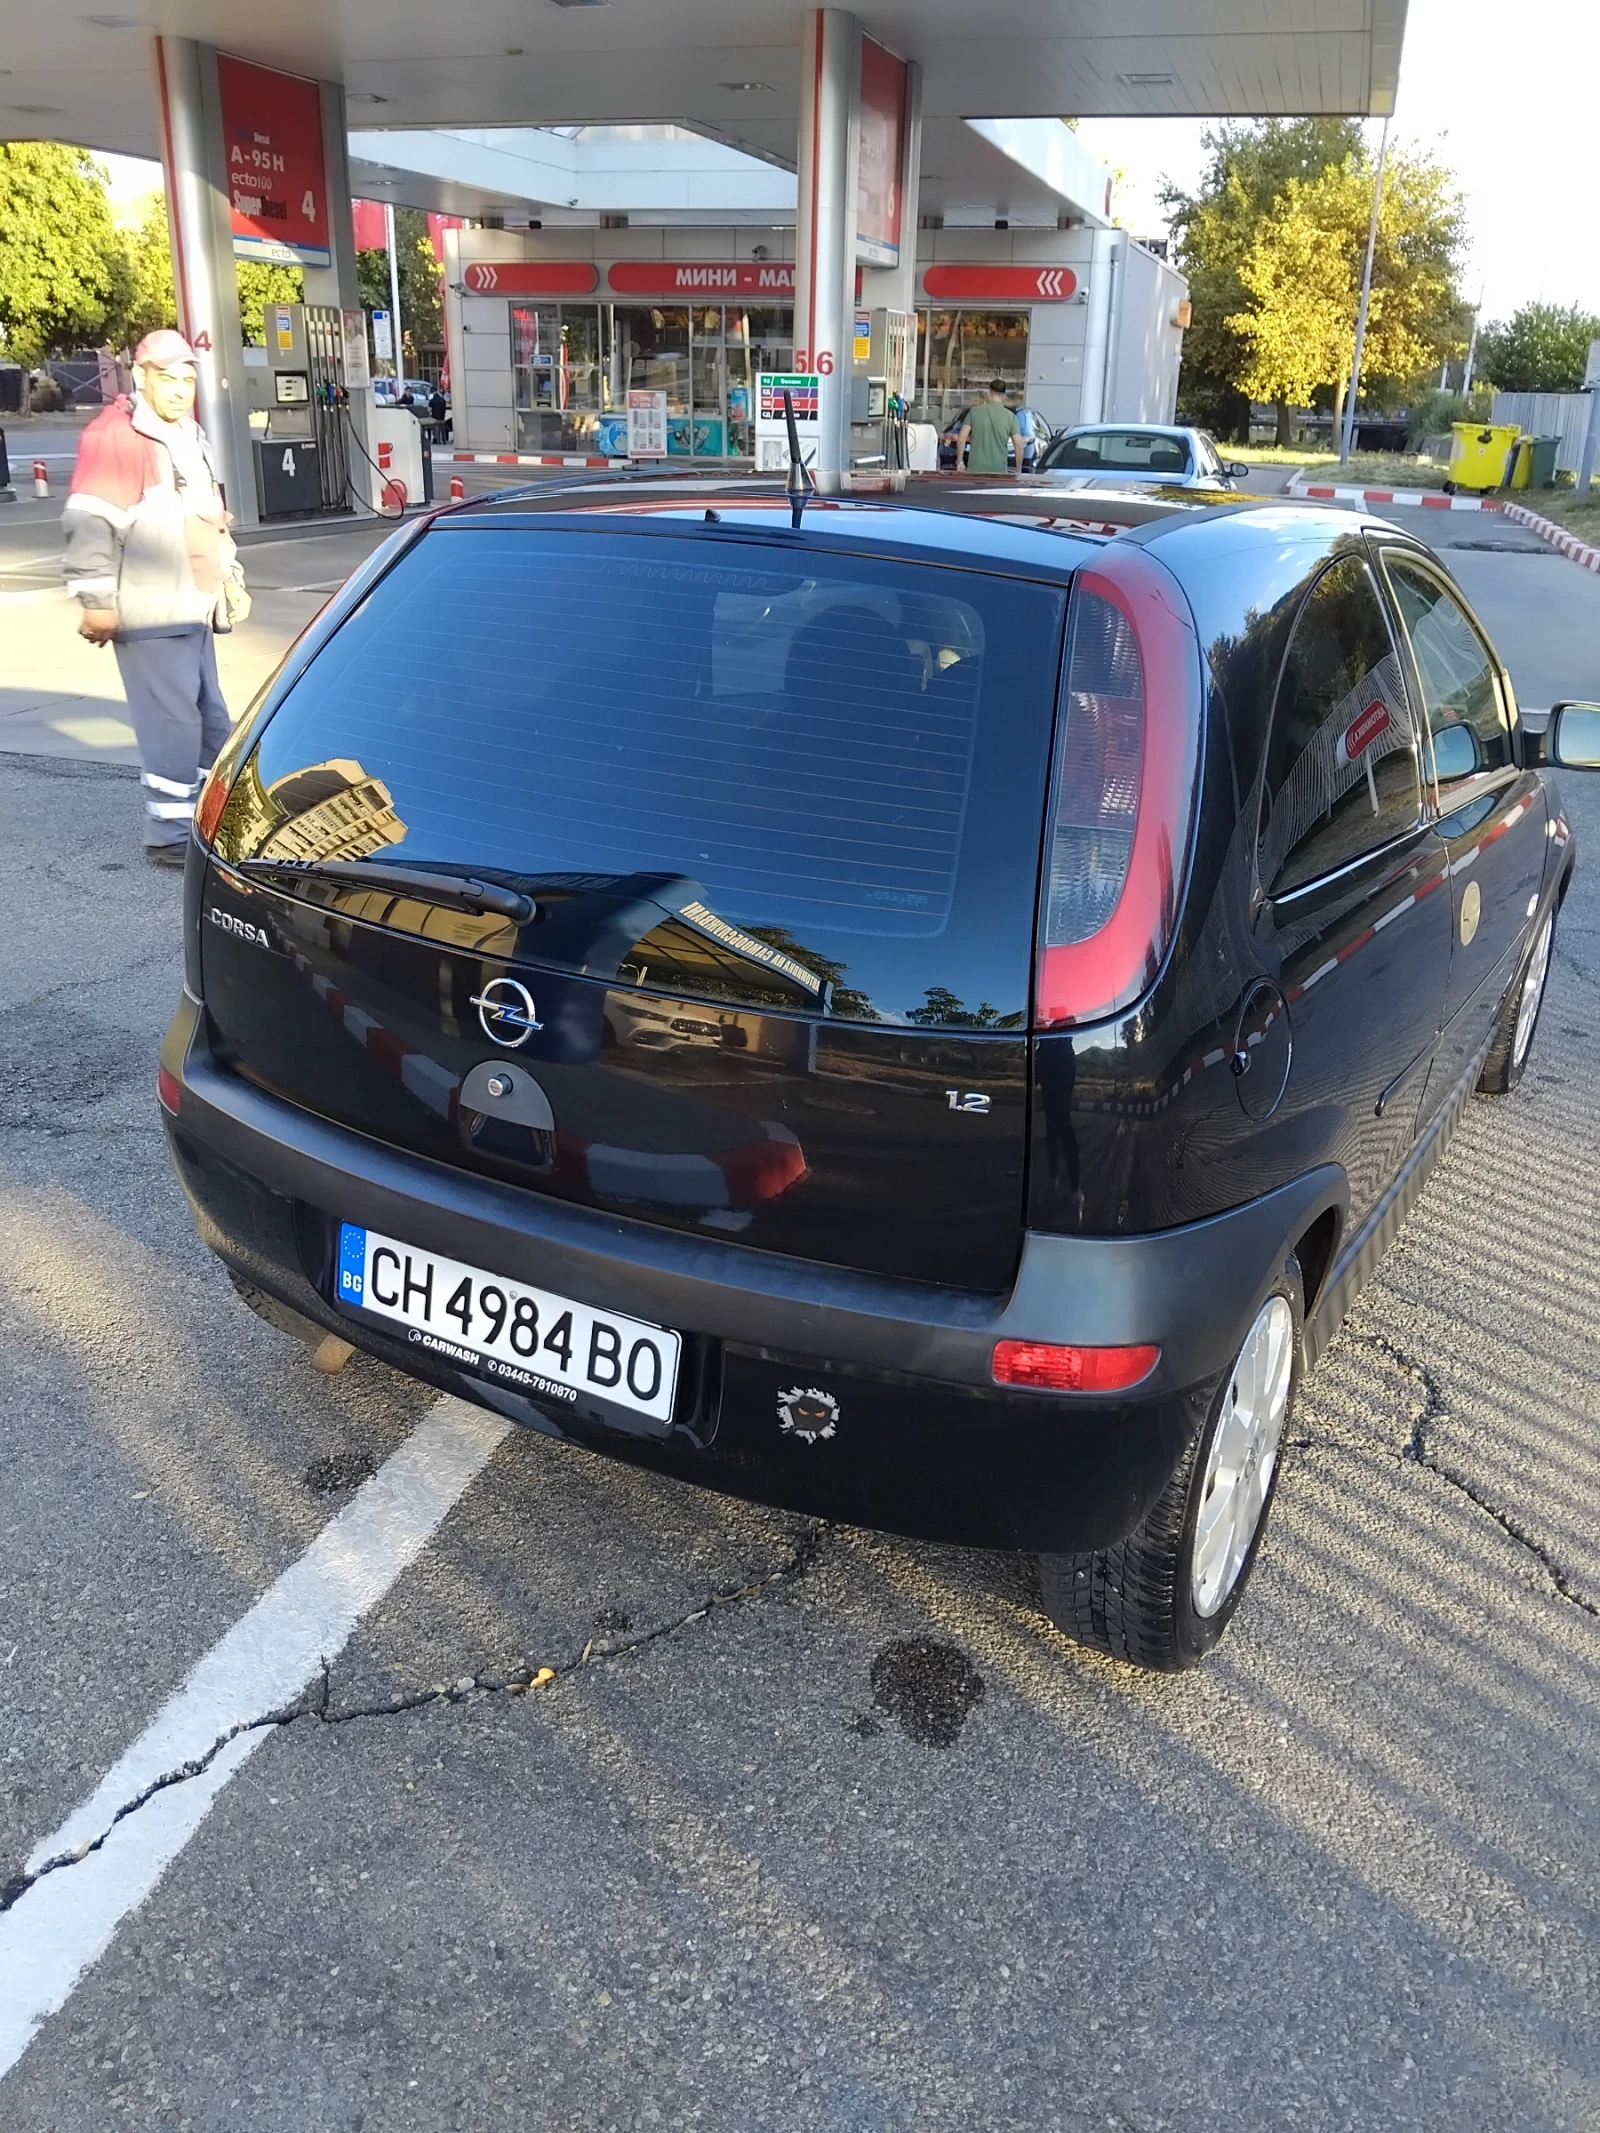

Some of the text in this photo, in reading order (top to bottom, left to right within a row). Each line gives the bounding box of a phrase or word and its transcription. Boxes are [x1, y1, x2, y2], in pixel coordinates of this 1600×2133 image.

[301, 190, 316, 222] 4
[271, 247, 291, 260] ecto
[675, 268, 737, 287] МИНИ
[193, 330, 212, 352] 4
[795, 351, 807, 374] 5
[816, 352, 833, 375] 6
[281, 447, 297, 478] 4
[211, 907, 270, 949] CORSA
[945, 1090, 991, 1114] 1.2
[342, 1270, 363, 1293] BG
[371, 1246, 434, 1322] CH
[445, 1276, 574, 1373] 4984
[422, 1335, 579, 1402] CARWASH 03445-7810870
